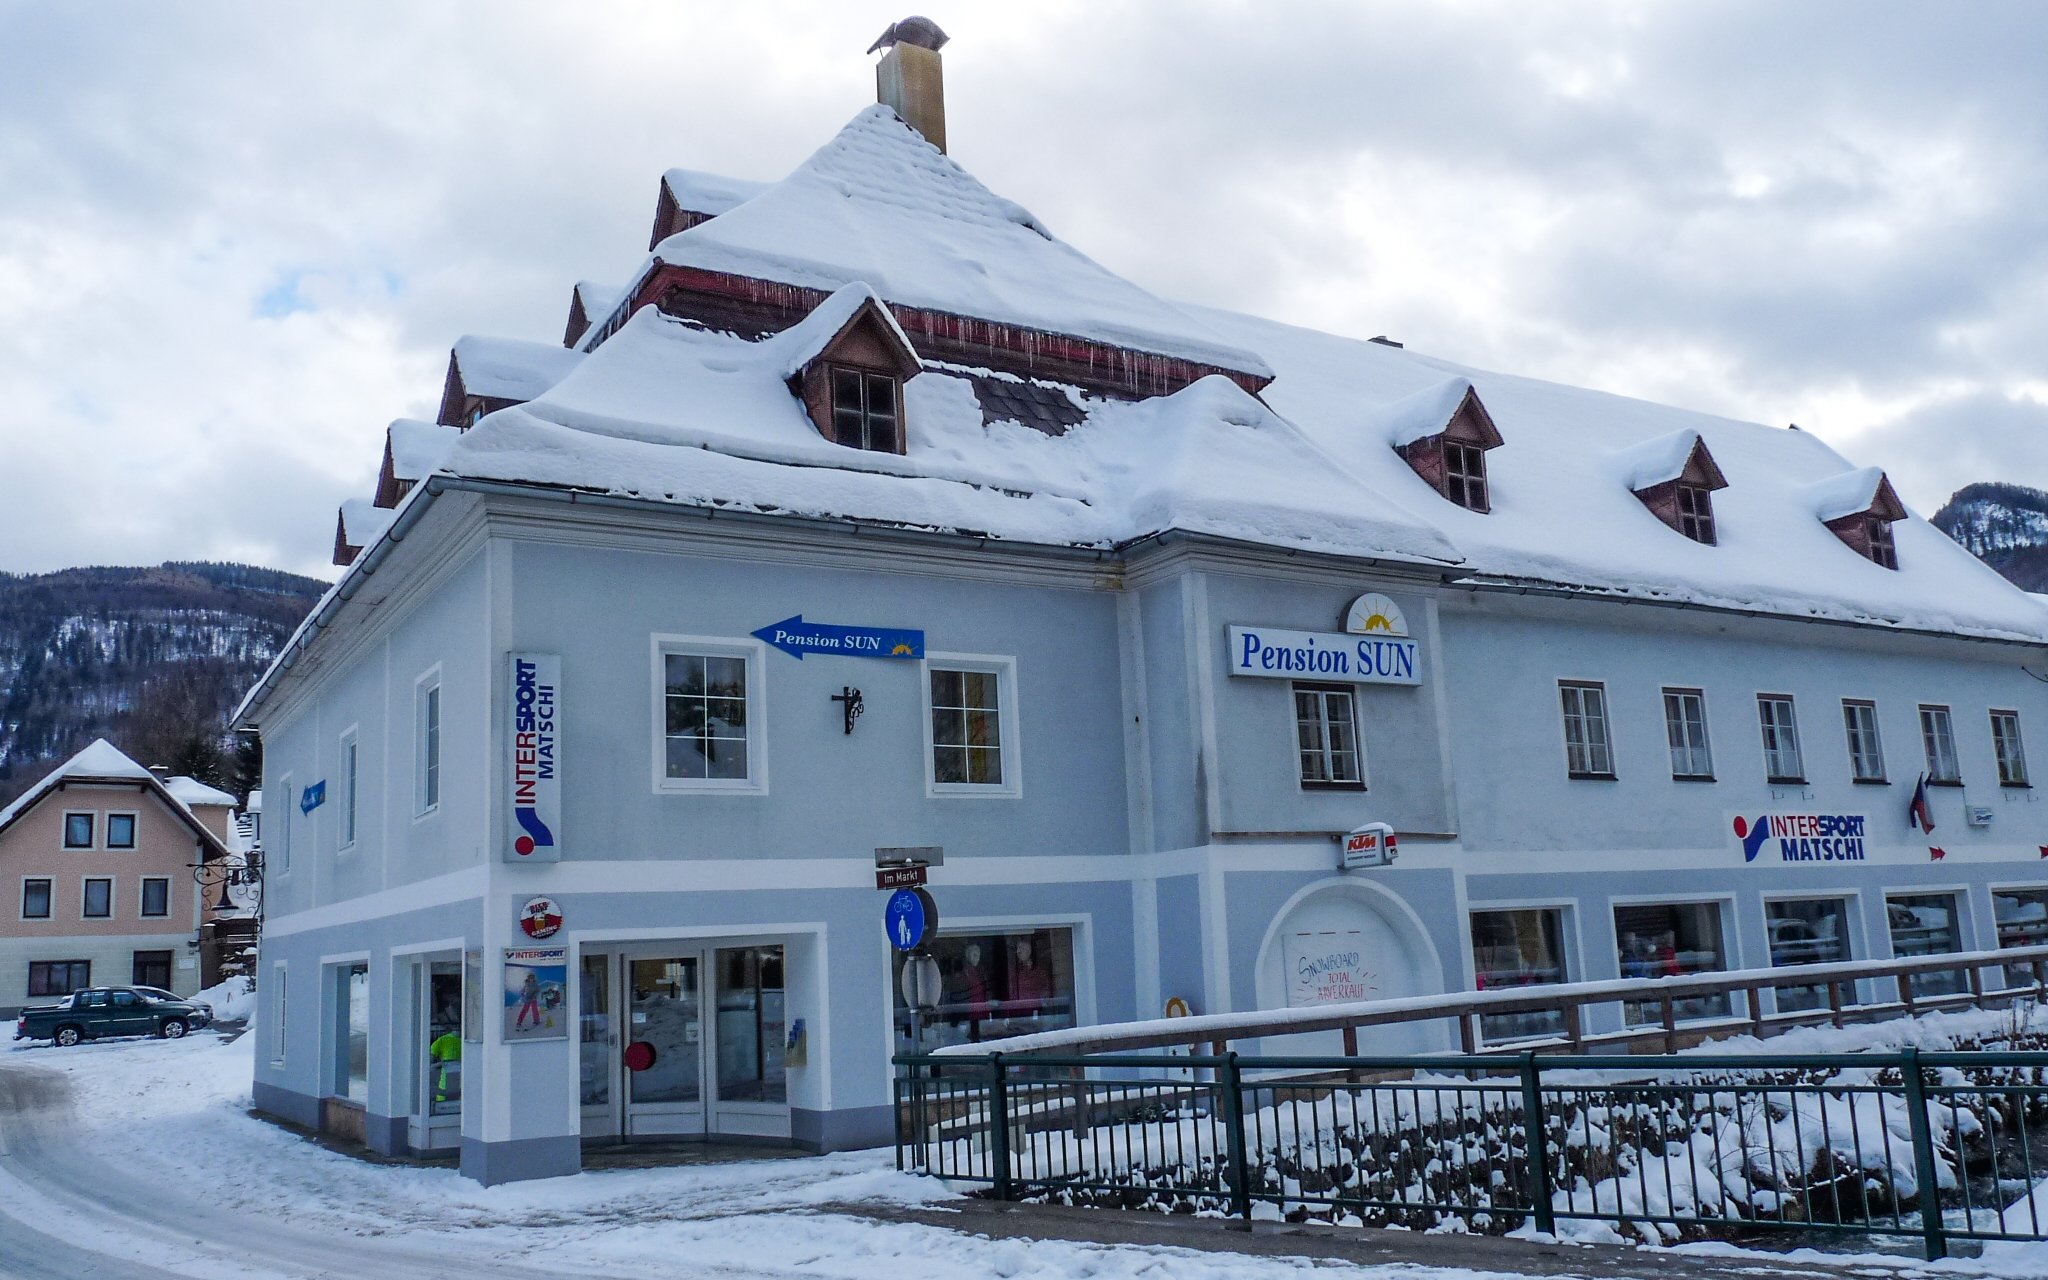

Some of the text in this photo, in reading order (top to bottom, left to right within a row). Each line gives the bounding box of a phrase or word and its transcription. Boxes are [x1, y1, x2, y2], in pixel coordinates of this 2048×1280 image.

[774, 630, 882, 650] Pension SUN
[1241, 633, 1415, 678] Pension SUN
[515, 658, 537, 804] INTERSPORT
[538, 685, 554, 779] MATSCHI
[1770, 815, 1865, 837] INTERSPORT
[1347, 834, 1376, 851] KTM
[1780, 838, 1865, 861] MATSCHI
[884, 870, 918, 884] Im Markt
[515, 950, 564, 959] INTERSPORT
[1298, 952, 1359, 984] SNOWBOARD
[1328, 972, 1352, 983] TOTAL
